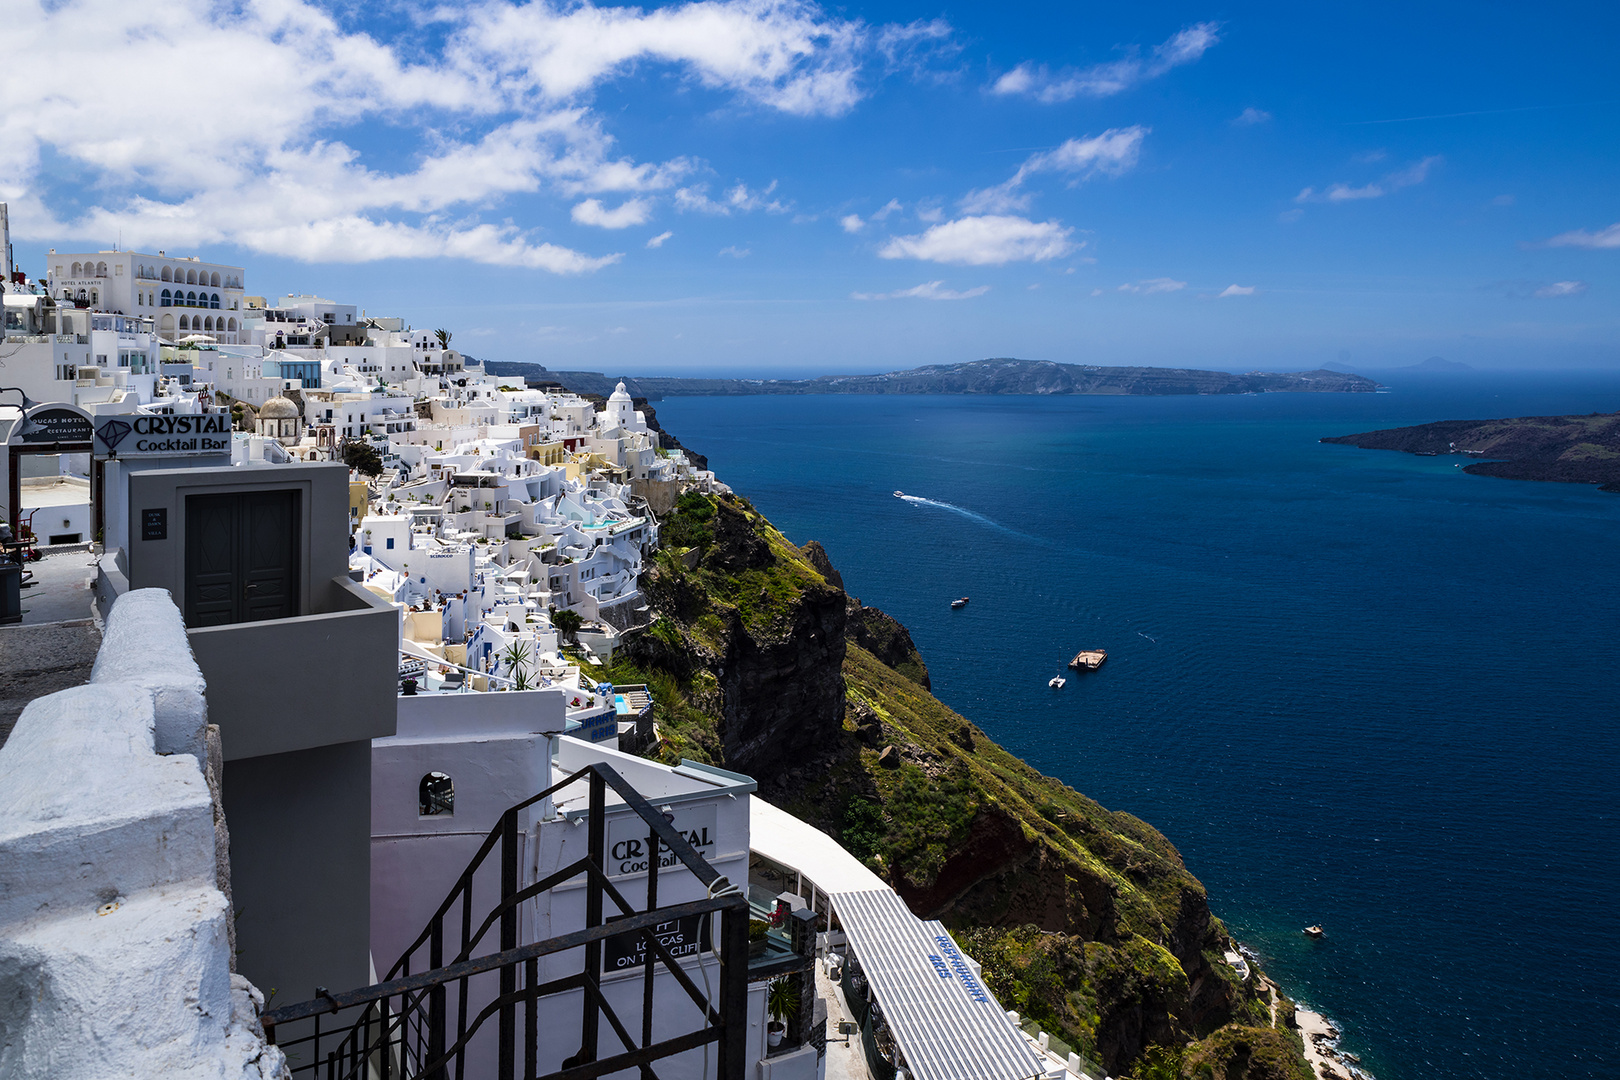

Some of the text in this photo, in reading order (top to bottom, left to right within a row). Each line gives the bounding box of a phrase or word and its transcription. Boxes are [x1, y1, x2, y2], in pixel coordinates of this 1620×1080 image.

[134, 416, 230, 434] CRYSTAL
[136, 438, 228, 451] Cocktail Bar
[592, 724, 616, 740] ARIS
[612, 828, 714, 860] CRSAL
[620, 853, 676, 874] Coctail
[636, 934, 684, 952] LCAS
[616, 955, 636, 966] ON
[928, 955, 952, 978] ARIS
